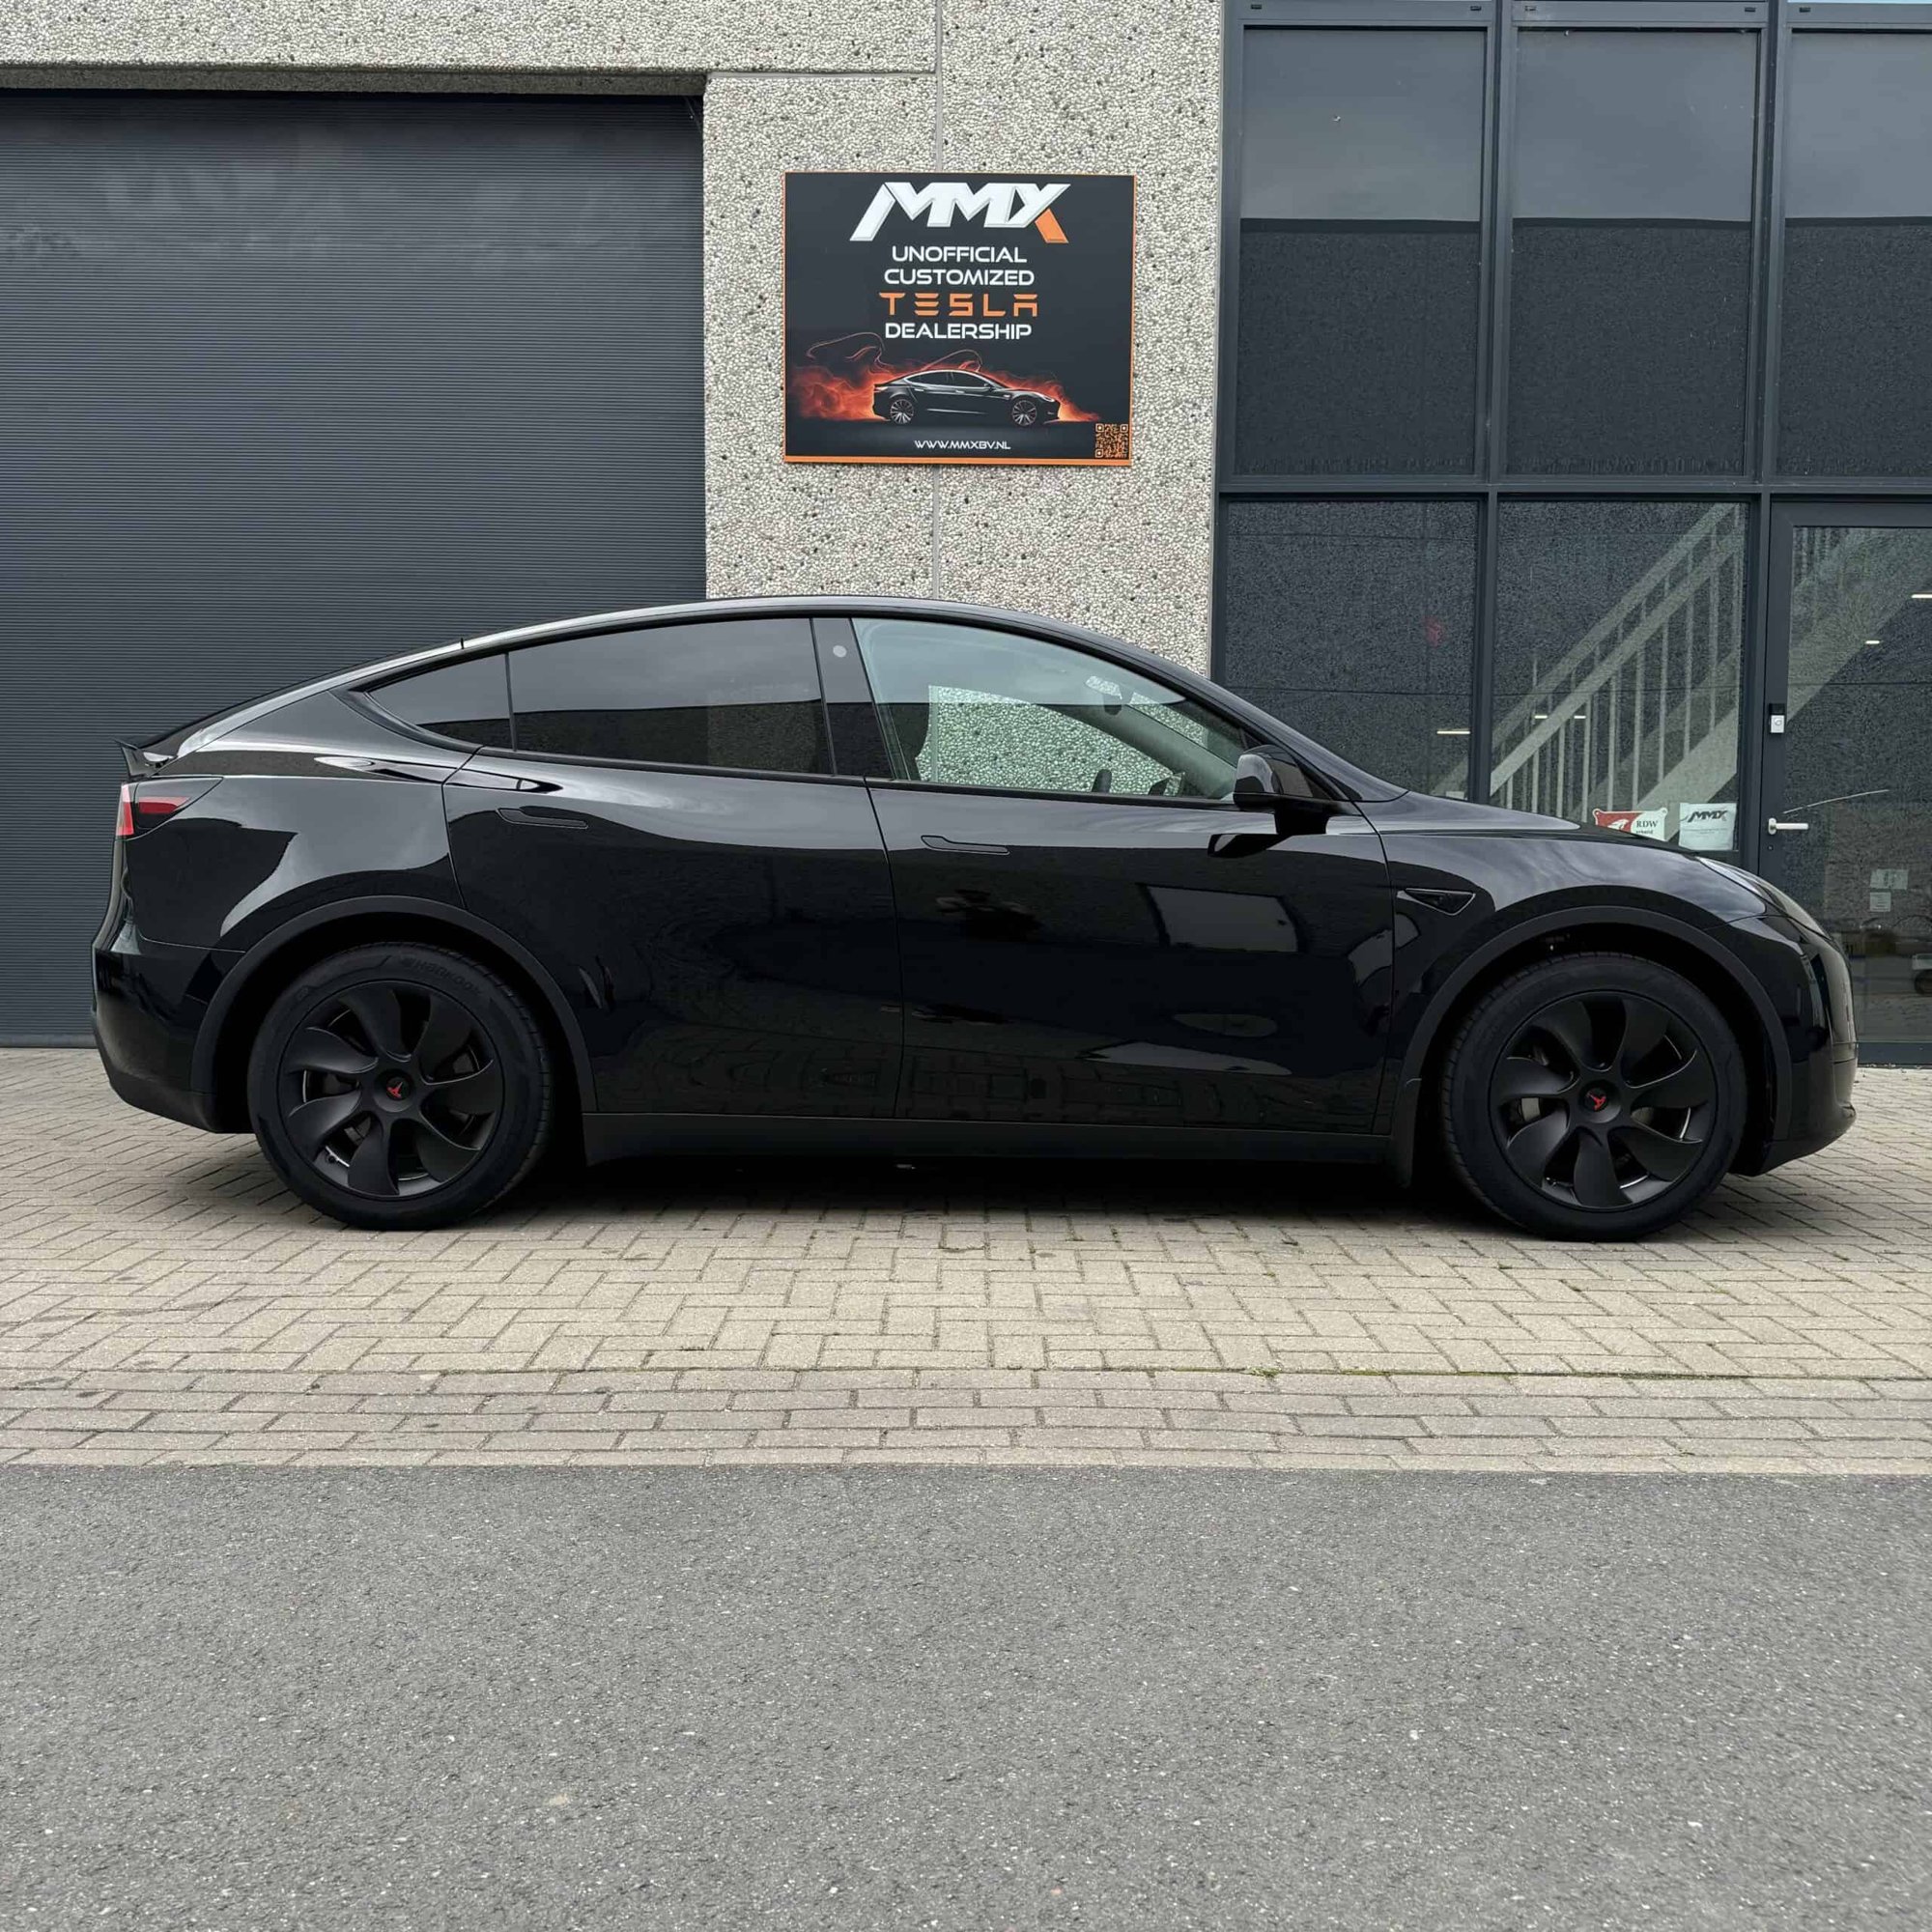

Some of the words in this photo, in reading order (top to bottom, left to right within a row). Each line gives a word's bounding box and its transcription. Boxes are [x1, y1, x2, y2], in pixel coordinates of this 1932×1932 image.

[850, 182, 1071, 243] MMX
[892, 245, 1028, 263] UNOFFICIAL
[884, 269, 1035, 286] CUSTOMIZED
[879, 292, 1037, 317] TESLA
[885, 323, 1032, 340] DEALERSHIP
[914, 440, 1011, 450] WWW.MMXBV.NL
